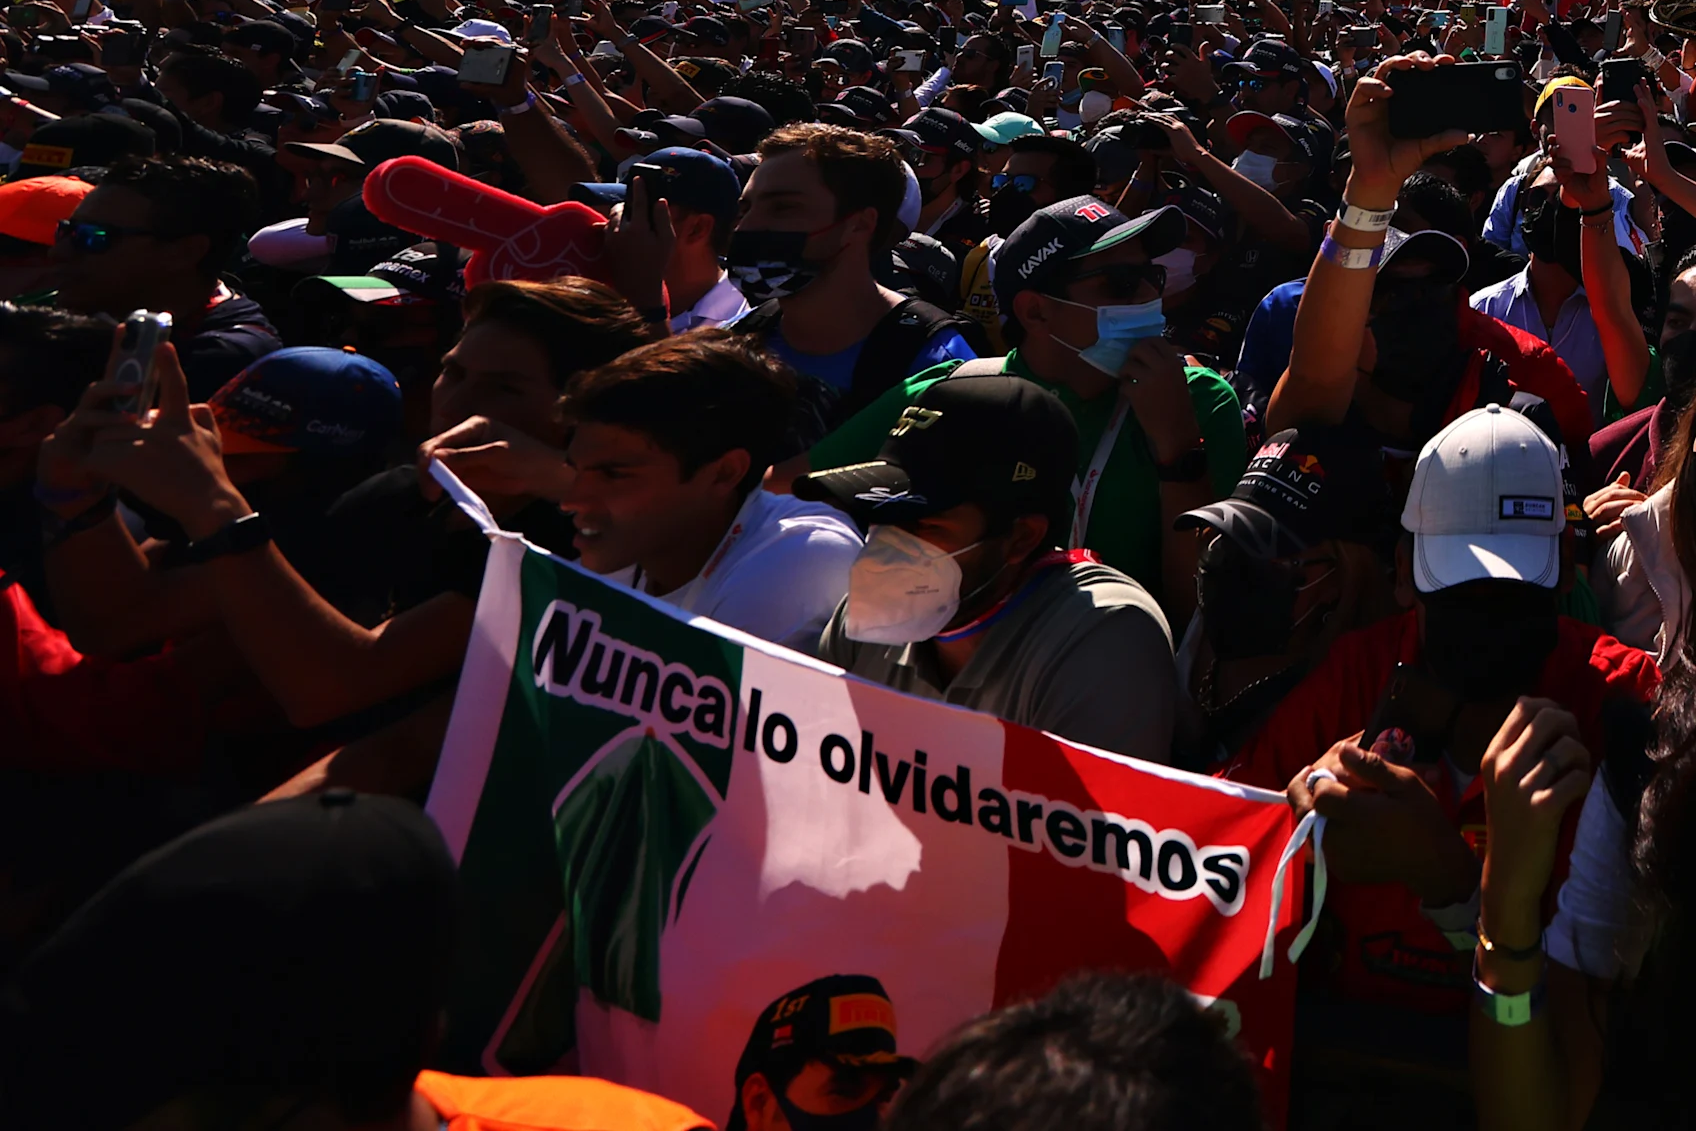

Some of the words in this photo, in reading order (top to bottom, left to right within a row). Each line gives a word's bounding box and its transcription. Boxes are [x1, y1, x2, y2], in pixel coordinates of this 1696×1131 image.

[1074, 204, 1109, 223] 11
[1017, 236, 1065, 281] KAVAK
[534, 609, 726, 740] Nunca
[743, 687, 797, 764] lo
[819, 730, 1244, 904] olvidaremos
